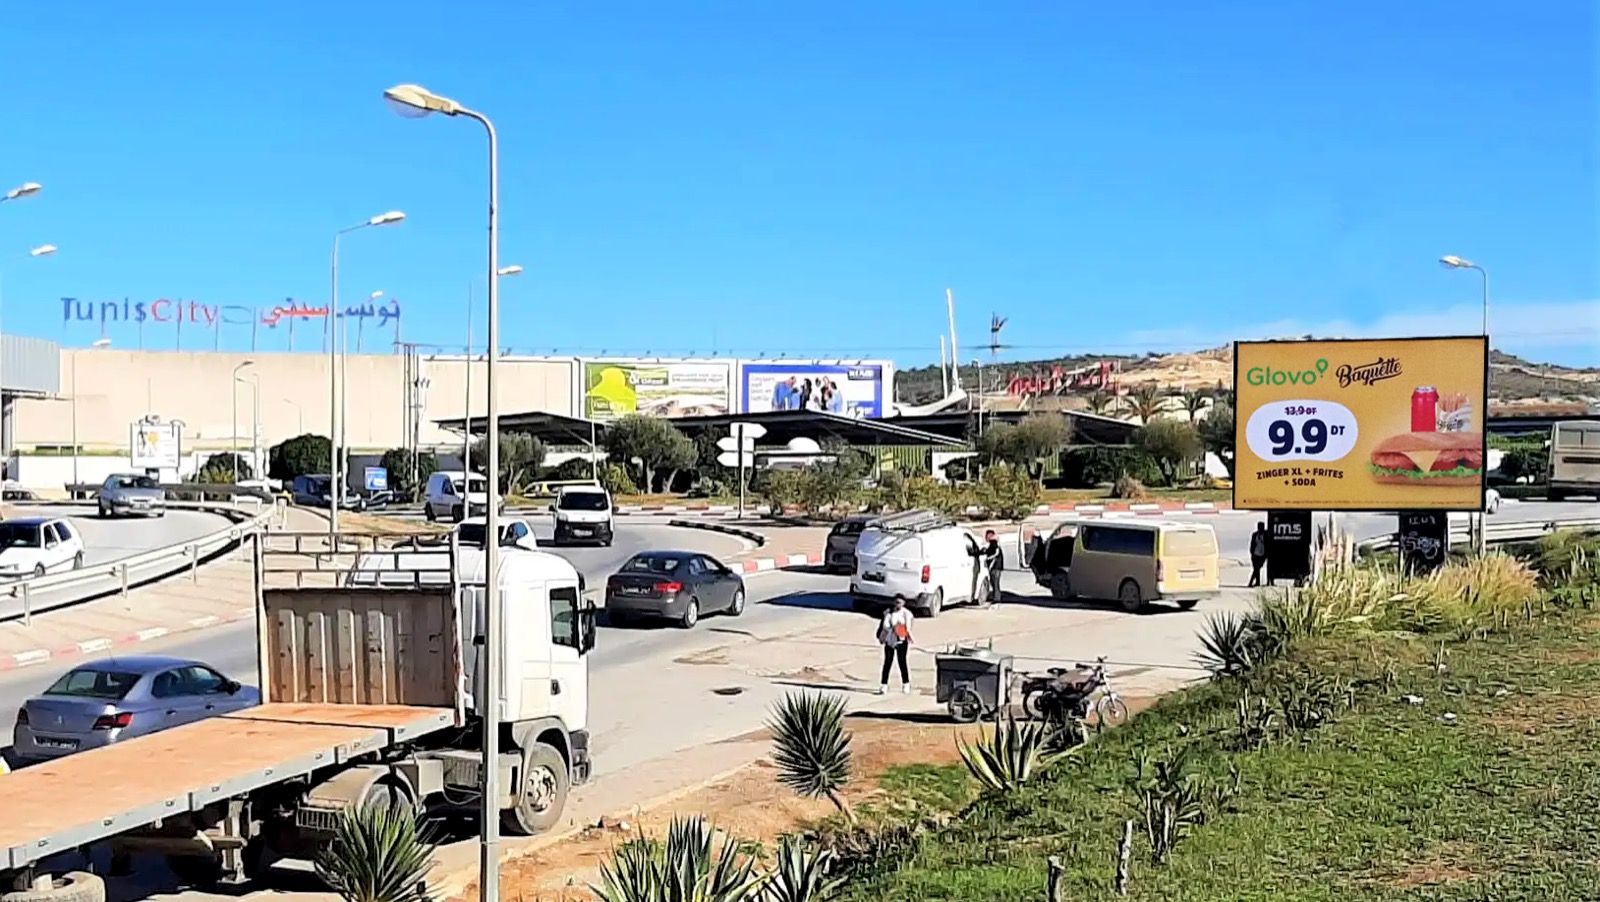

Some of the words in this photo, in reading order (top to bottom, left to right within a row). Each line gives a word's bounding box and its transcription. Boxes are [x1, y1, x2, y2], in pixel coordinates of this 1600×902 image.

[1246, 366, 1318, 386] Glovo
[1335, 357, 1403, 389] Baguette
[1305, 407, 1317, 415] DT
[1268, 418, 1328, 456] 9.9
[1330, 425, 1345, 436] DT
[1256, 468, 1289, 480] ZINGER
[1291, 467, 1303, 476] XL
[1313, 467, 1344, 479] FRITES
[1292, 478, 1316, 487] SODA
